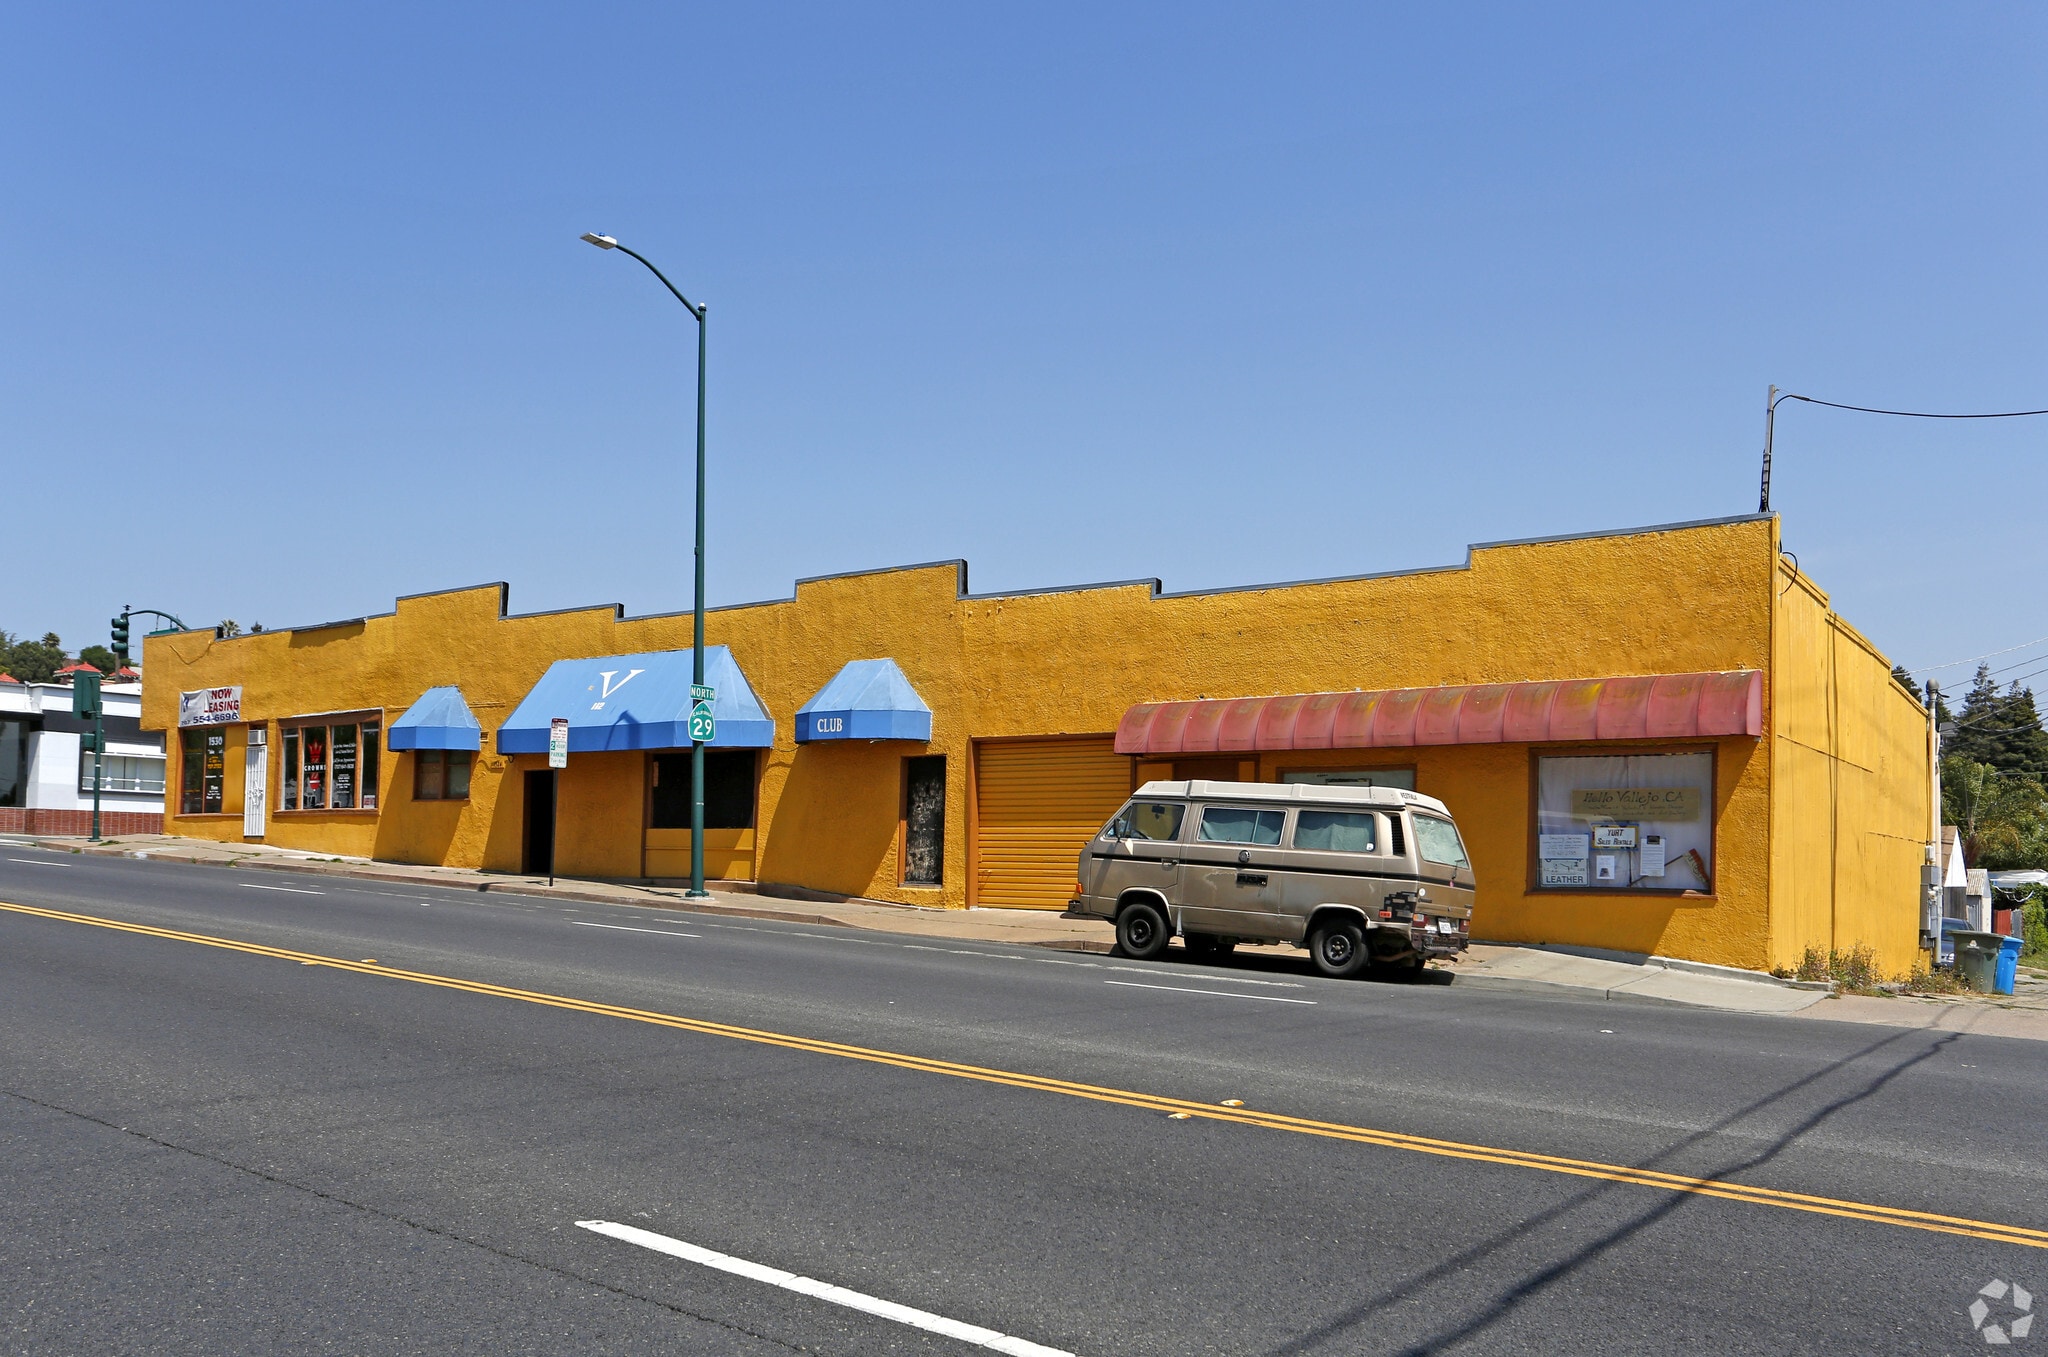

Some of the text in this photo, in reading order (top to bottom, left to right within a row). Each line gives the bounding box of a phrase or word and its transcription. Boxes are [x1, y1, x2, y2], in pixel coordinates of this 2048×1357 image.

[600, 669, 646, 699] V
[211, 688, 232, 700] NOW
[691, 687, 714, 699] NORTH
[693, 718, 712, 736] 29
[817, 717, 843, 733] CLUB
[208, 736, 223, 746] 1530
[1583, 791, 1613, 803] Hello
[1616, 790, 1660, 806] Vallejo
[1545, 875, 1584, 884] LEATHER
